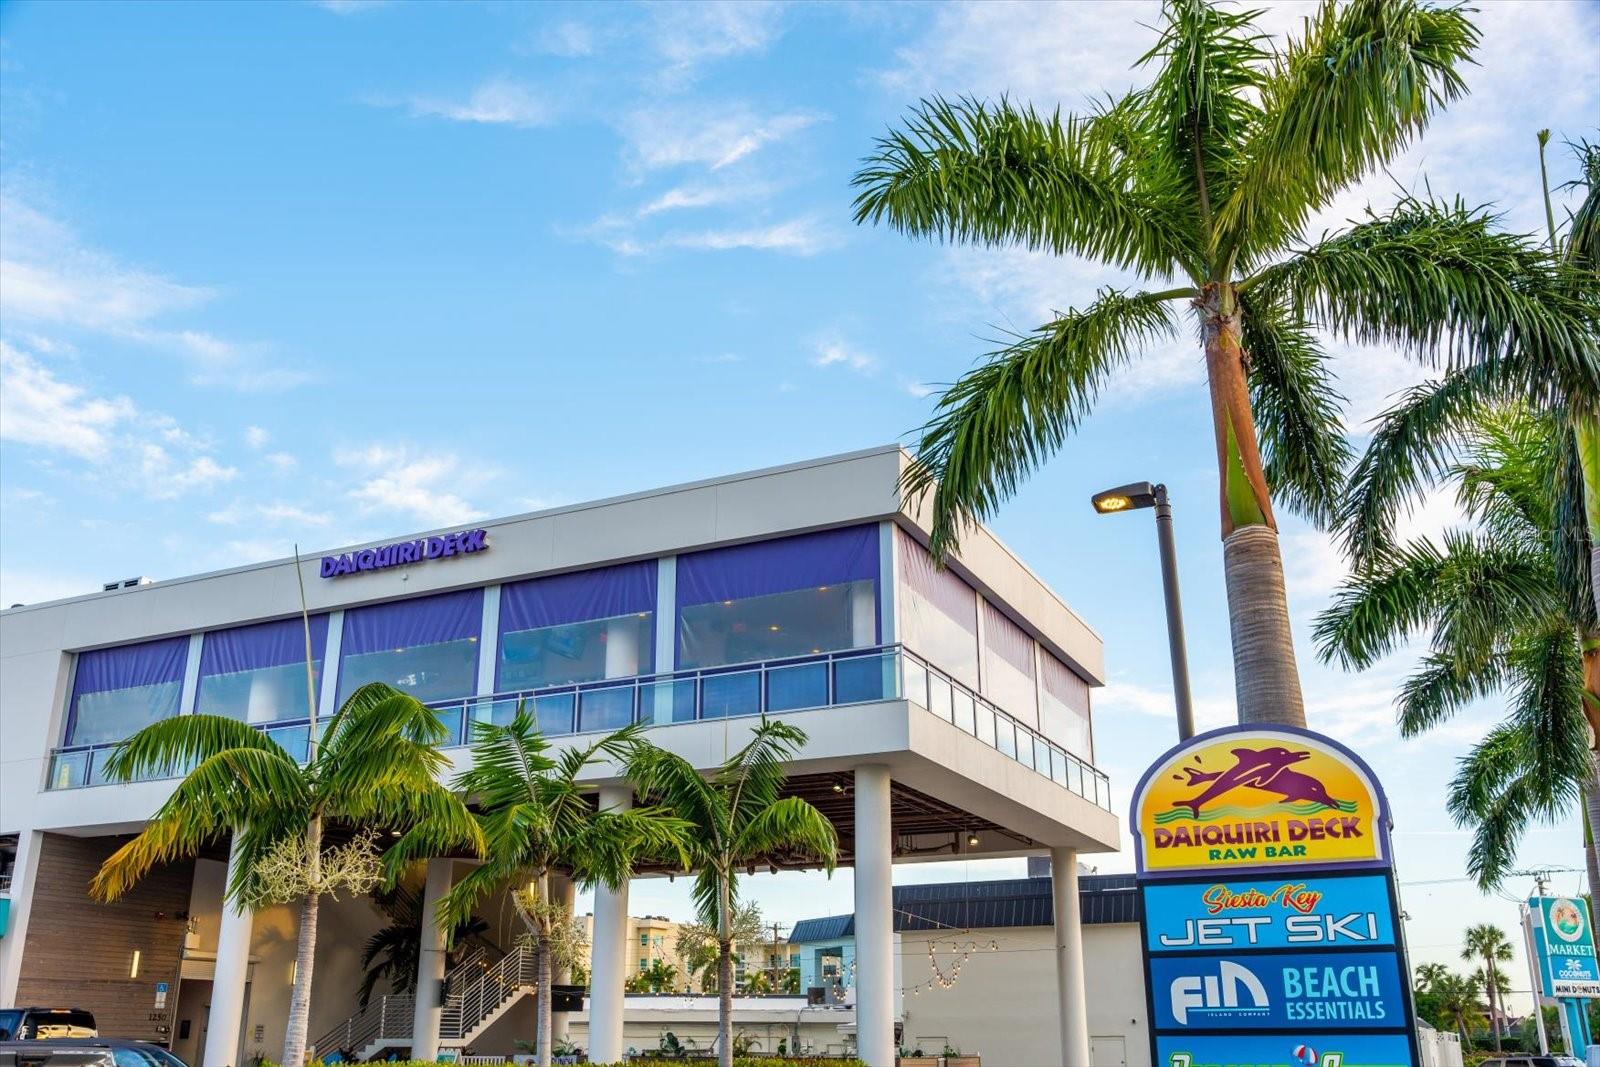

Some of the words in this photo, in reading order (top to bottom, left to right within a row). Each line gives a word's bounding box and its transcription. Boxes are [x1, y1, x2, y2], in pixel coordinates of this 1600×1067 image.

[320, 539, 424, 578] DAIQUIRI
[427, 528, 489, 559] DECK
[1153, 820, 1281, 849] DAIQUIRI
[1287, 816, 1363, 842] DECK
[1208, 847, 1257, 861] RAW
[1265, 844, 1307, 857] BAR
[1202, 884, 1270, 914] Siesta
[1271, 883, 1322, 914] Key
[1159, 916, 1272, 946] JET
[1285, 912, 1378, 943] SKI
[1549, 943, 1593, 956] MARKET
[1282, 966, 1380, 998] BEACH
[1555, 985, 1571, 993] MINI
[1286, 1001, 1386, 1020] ESSENTIALS
